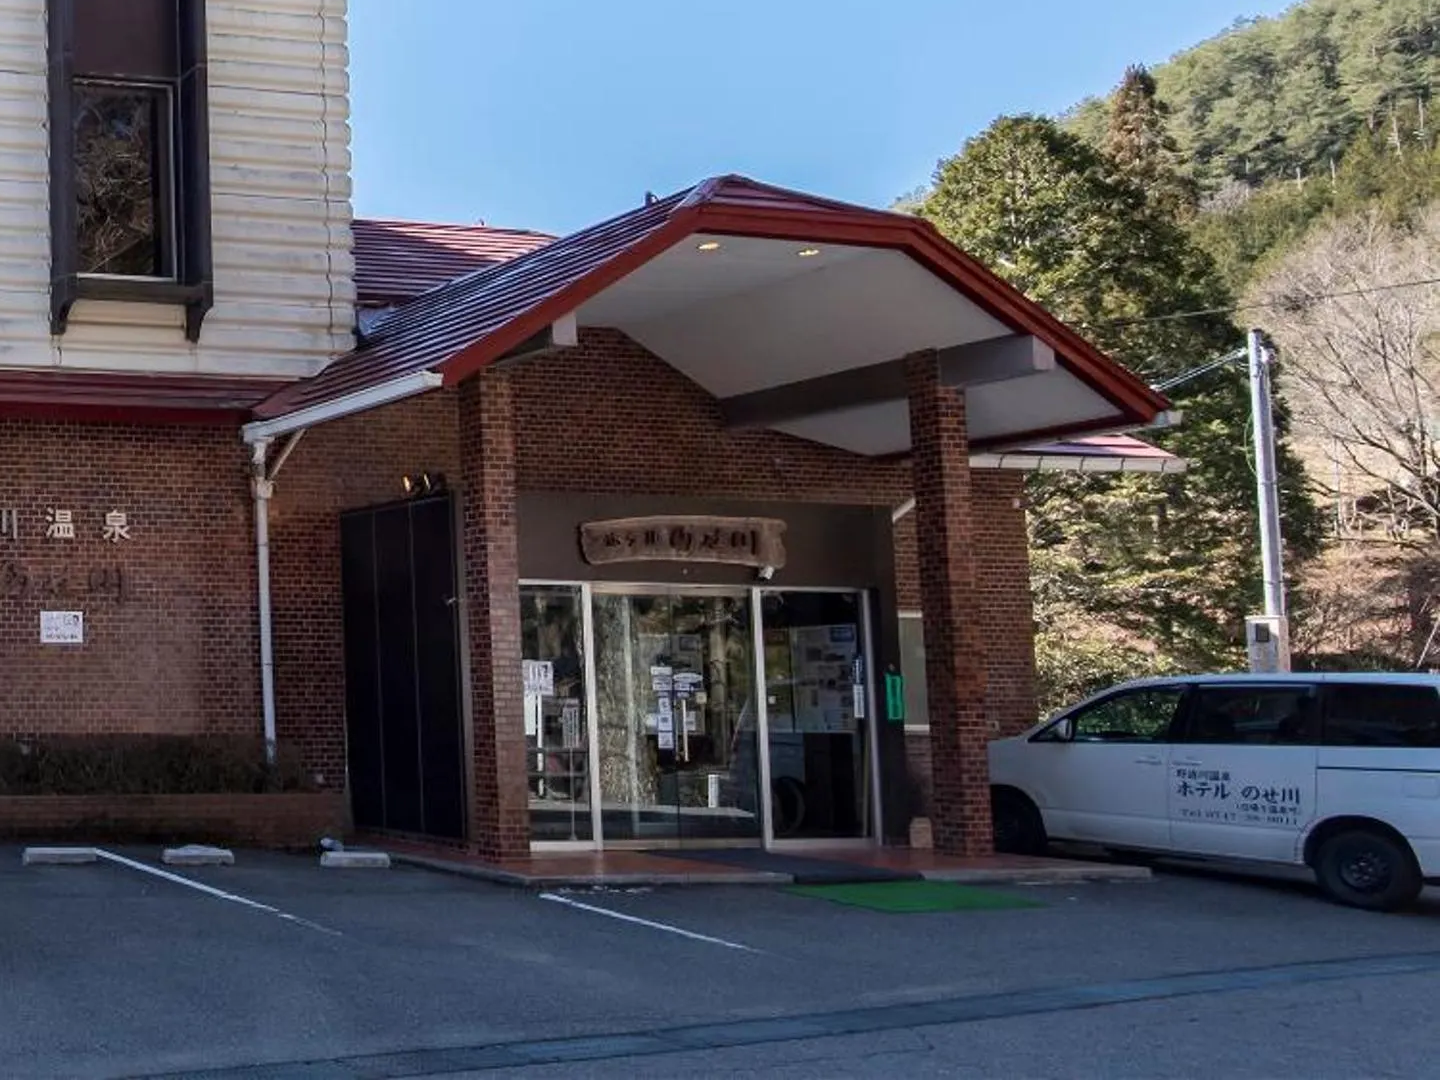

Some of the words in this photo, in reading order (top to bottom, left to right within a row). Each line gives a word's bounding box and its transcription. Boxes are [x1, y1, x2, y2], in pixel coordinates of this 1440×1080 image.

[1176, 781, 1231, 800] ホテル
[1240, 786, 1300, 805] のせ川
